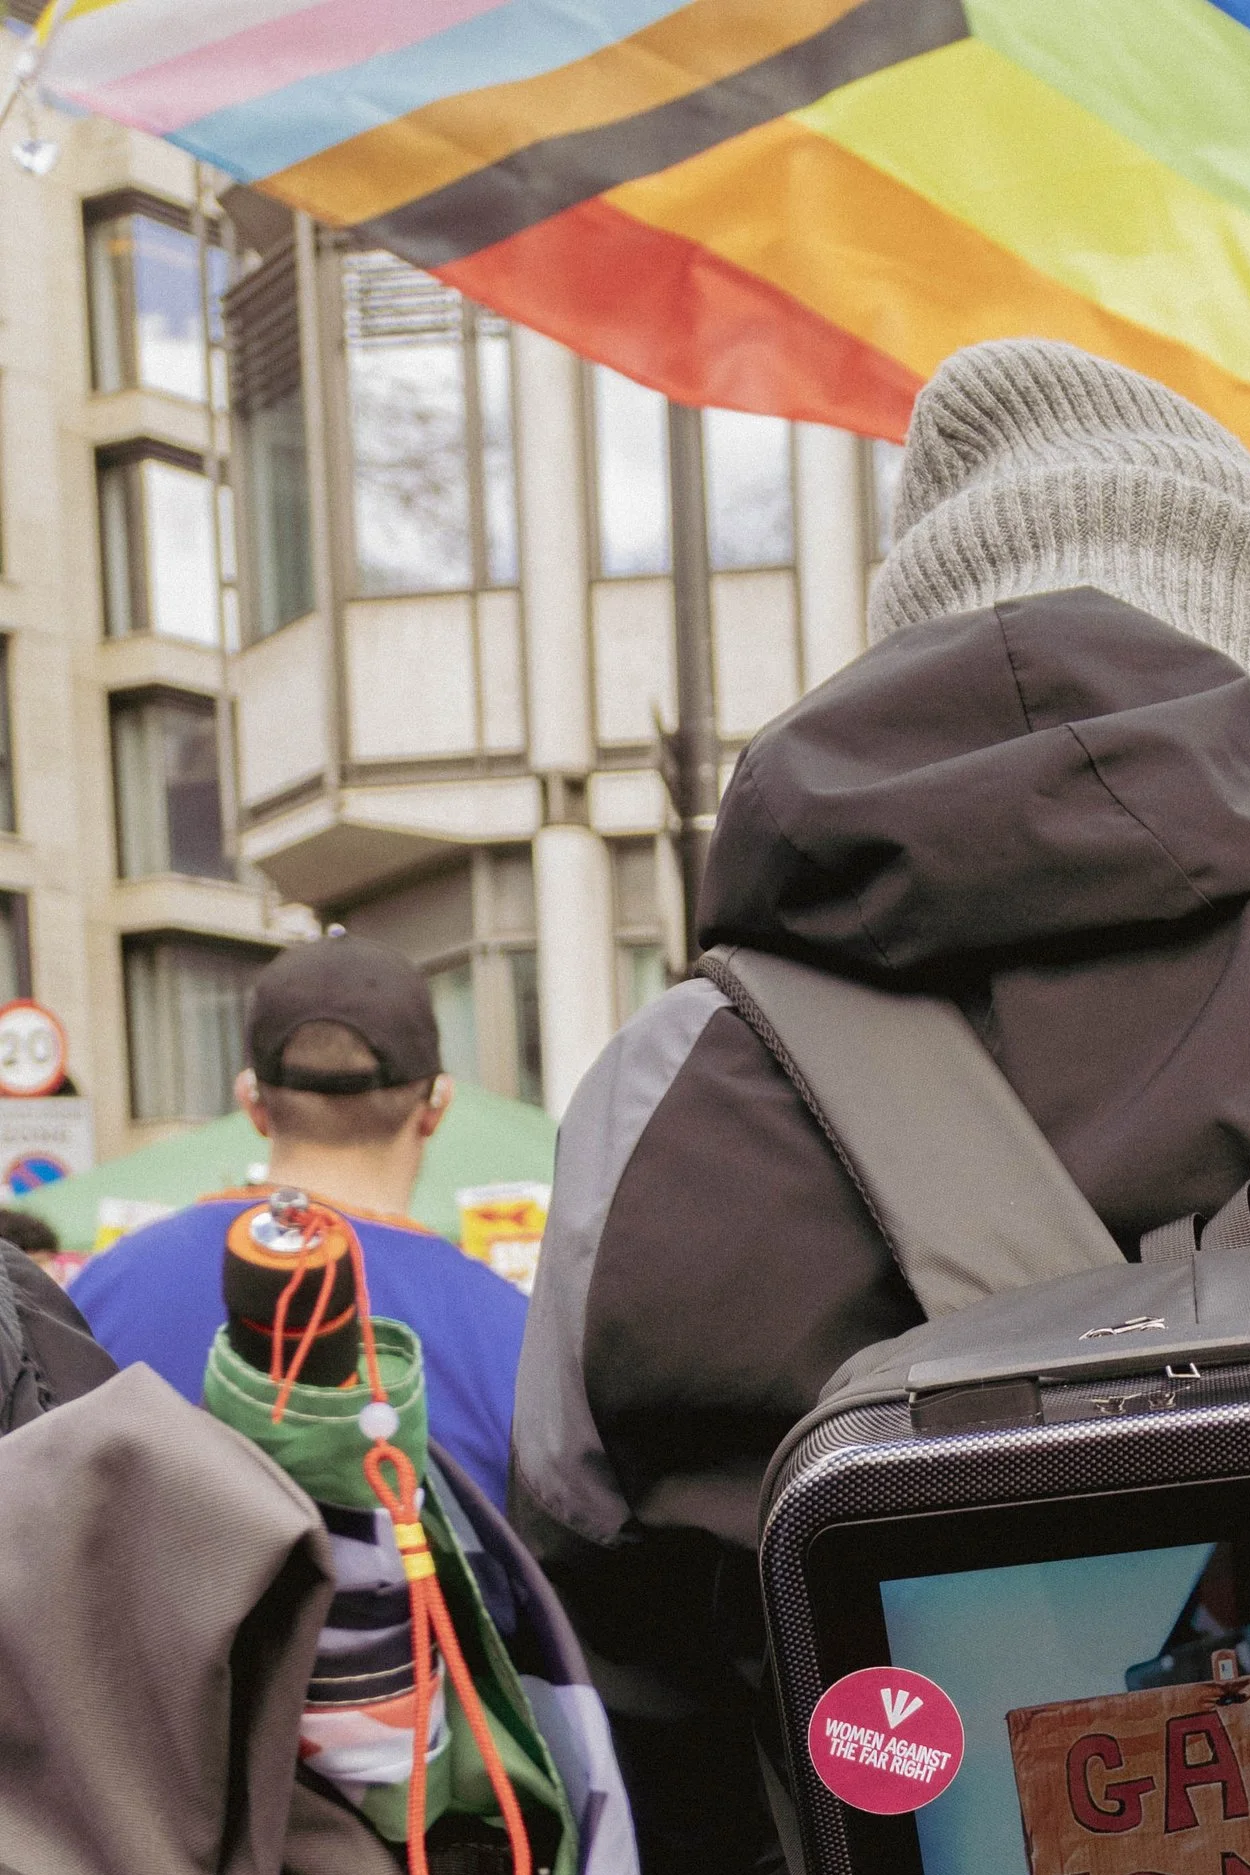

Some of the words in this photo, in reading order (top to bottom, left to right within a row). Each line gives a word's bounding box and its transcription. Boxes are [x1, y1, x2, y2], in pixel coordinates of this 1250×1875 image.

[0, 1028, 54, 1067] 20
[825, 1717, 885, 1751] WOMEN
[885, 1736, 952, 1771] AGAINST
[829, 1737, 858, 1761] THE
[859, 1747, 890, 1771] FAR
[889, 1756, 937, 1784] RIGHT
